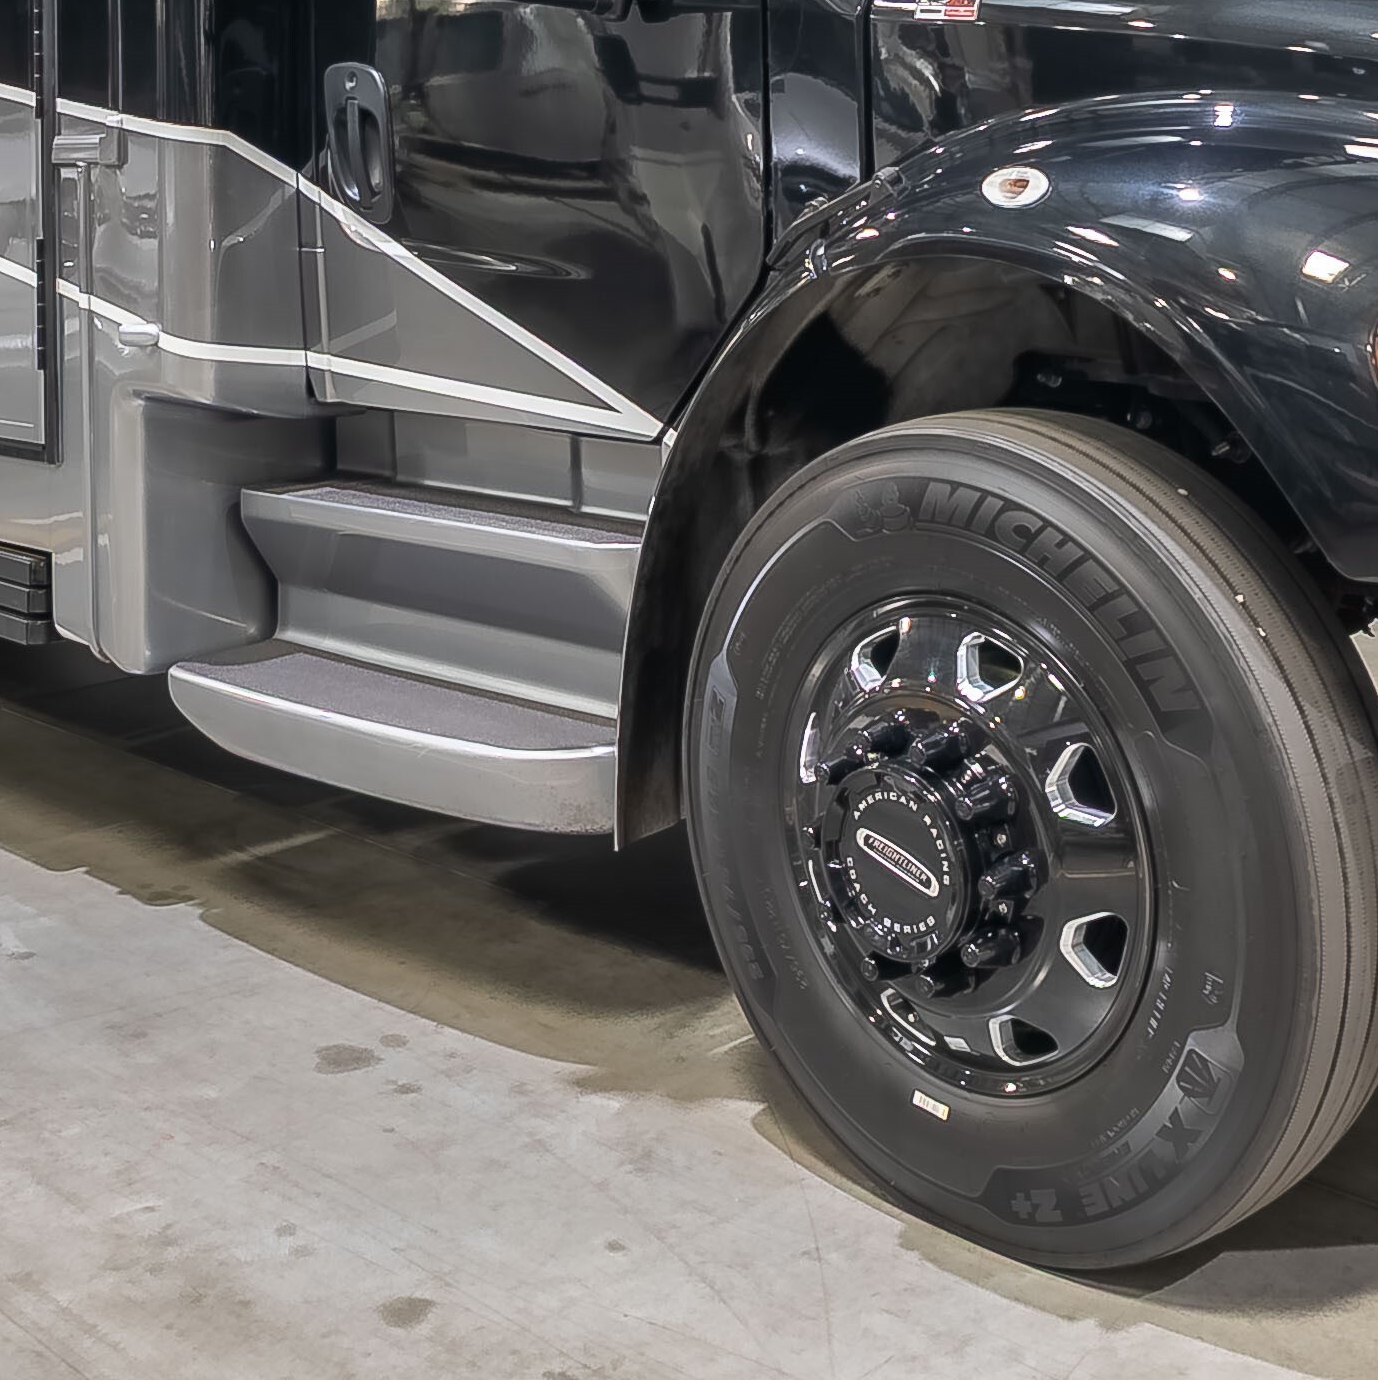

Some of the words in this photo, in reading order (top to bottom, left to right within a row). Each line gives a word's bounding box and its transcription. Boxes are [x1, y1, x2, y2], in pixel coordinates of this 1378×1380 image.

[918, 480, 1203, 712] MICHELIN
[853, 791, 918, 820] AMERICAN
[923, 814, 951, 886] RACING
[868, 837, 928, 883] FREIGHTLINER
[846, 856, 877, 916] COACH
[883, 914, 936, 935] SERIES
